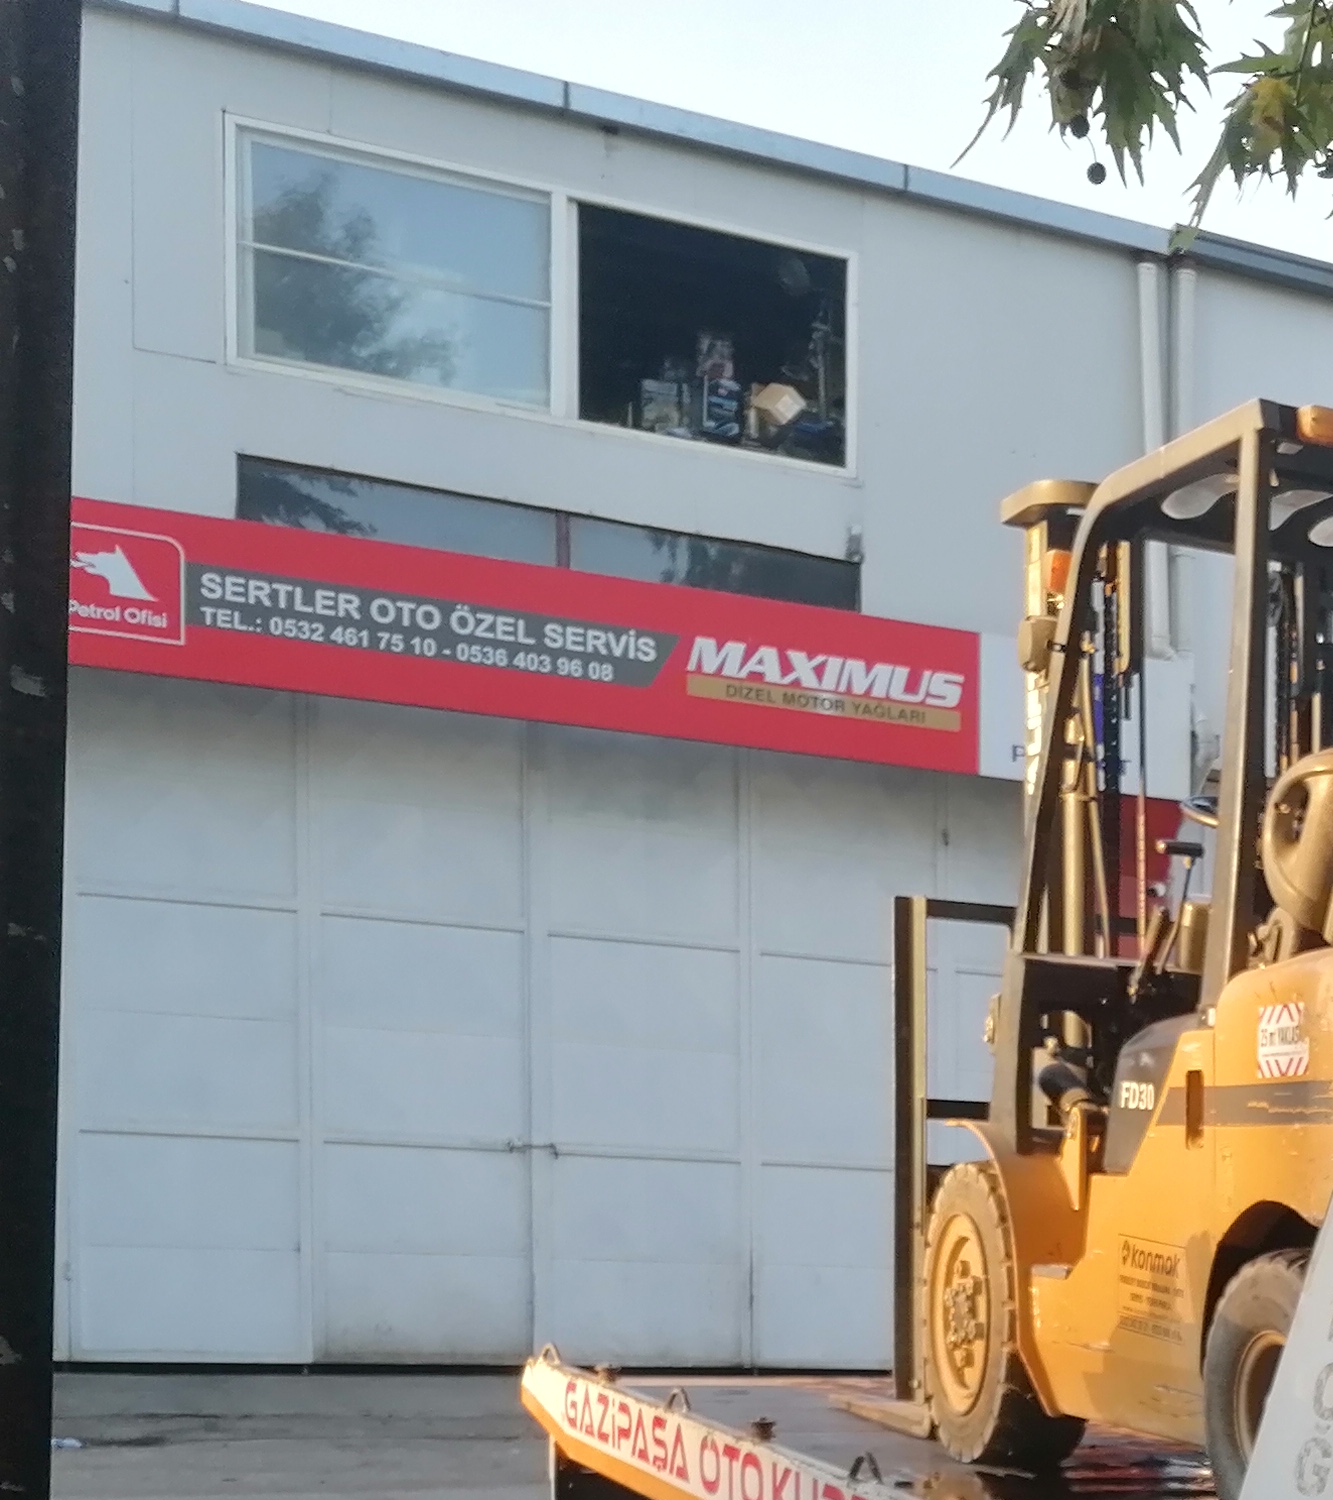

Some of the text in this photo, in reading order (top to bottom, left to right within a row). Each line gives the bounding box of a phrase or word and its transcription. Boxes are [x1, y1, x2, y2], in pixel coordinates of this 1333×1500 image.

[69, 600, 168, 628] Petrol Ofisi
[200, 573, 658, 663] SERTLER OTO ÖZEL SERVİS
[269, 617, 325, 641] 0532
[330, 626, 370, 648] 461
[377, 632, 405, 653] 75
[410, 637, 437, 657] 10
[456, 643, 508, 667] 0536
[512, 651, 552, 673] 403
[557, 657, 583, 678] 96
[588, 662, 615, 682] 08
[686, 635, 965, 709] MAXIMUS
[782, 691, 846, 713] MOTOR
[1120, 1080, 1155, 1110] FD30
